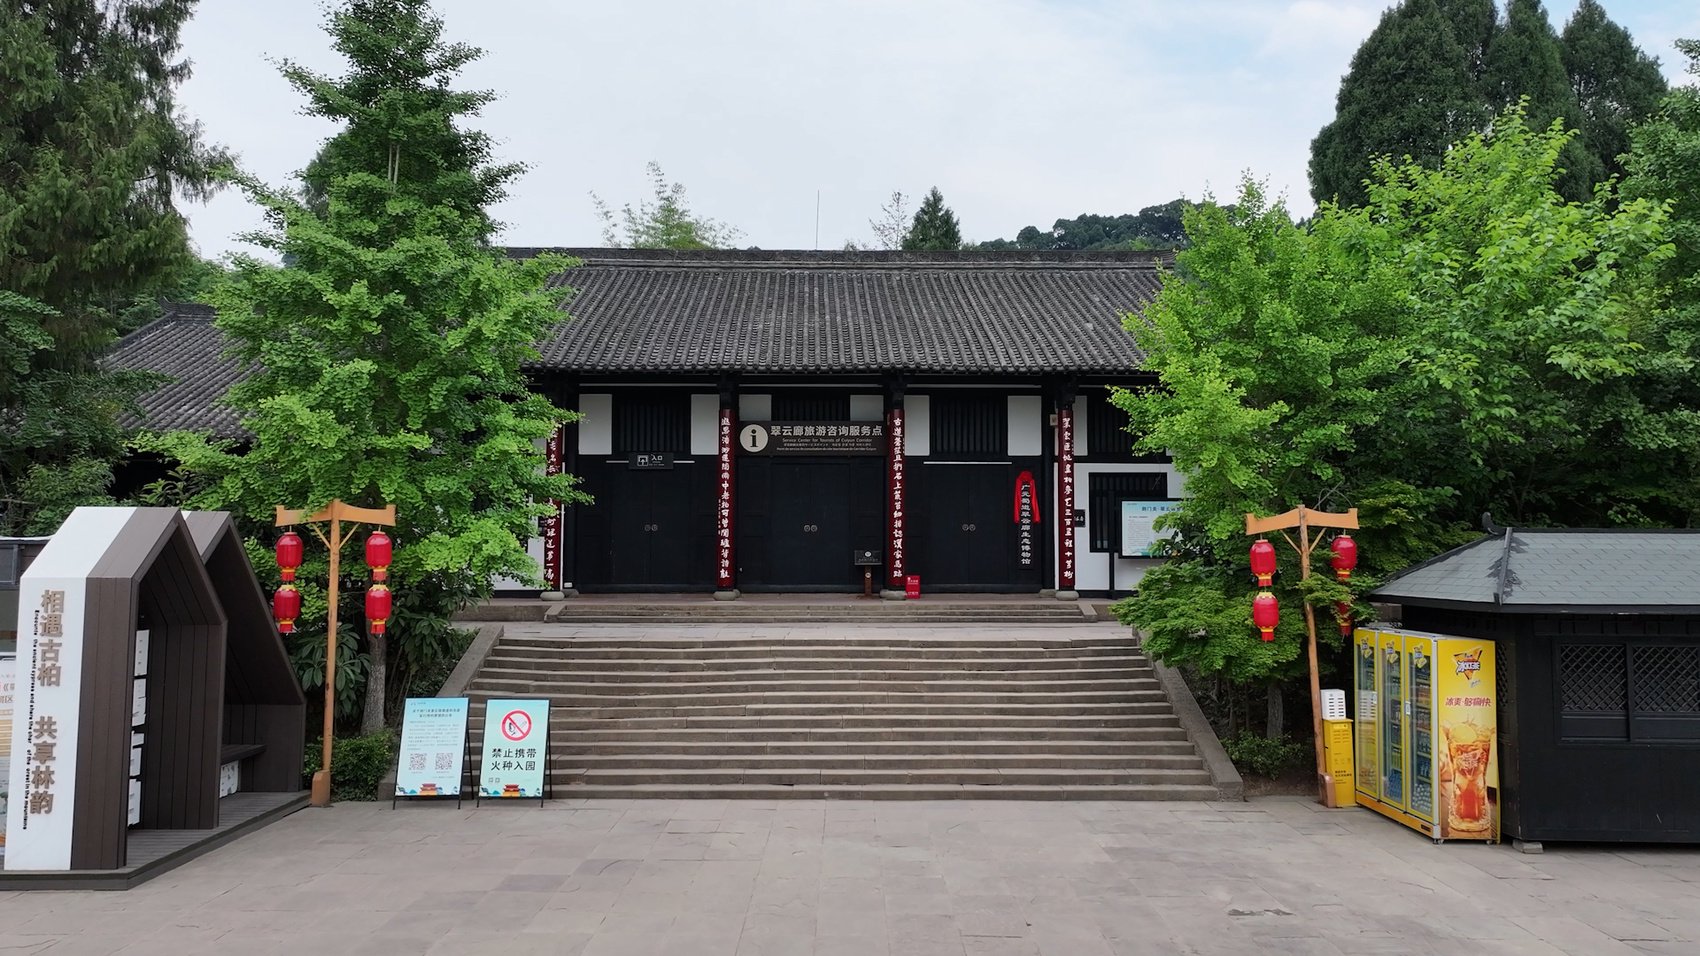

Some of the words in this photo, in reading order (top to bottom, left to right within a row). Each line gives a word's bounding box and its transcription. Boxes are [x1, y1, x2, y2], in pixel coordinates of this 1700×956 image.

[770, 425, 883, 437] 翠云廊旅游咨询服务点
[37, 589, 65, 688] 相遇古柏
[491, 747, 537, 759] 禁止携带
[29, 715, 58, 815] 共享林韵
[490, 760, 536, 771] 火种入园
